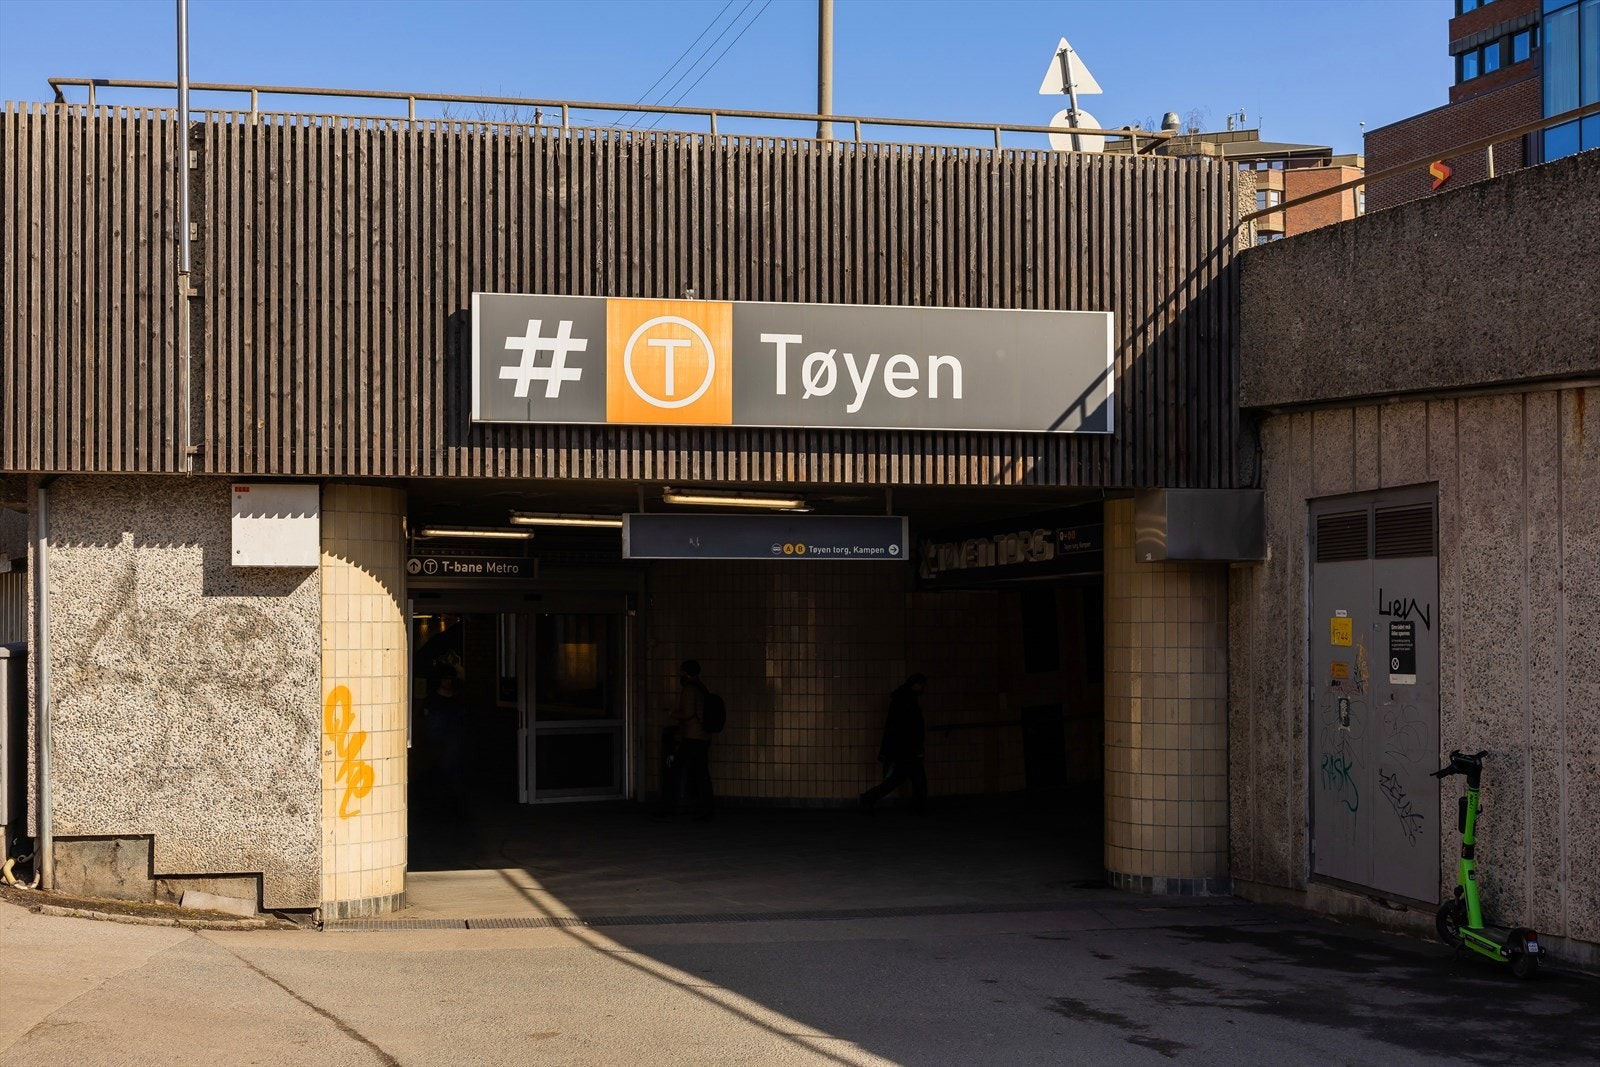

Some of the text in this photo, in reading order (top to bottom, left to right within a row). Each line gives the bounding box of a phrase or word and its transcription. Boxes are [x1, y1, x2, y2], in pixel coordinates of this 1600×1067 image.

[760, 333, 963, 413] Tøyen
[809, 545, 831, 555] Tøyen
[833, 545, 851, 555] torg,
[853, 546, 885, 555] Kampen
[442, 561, 483, 573] T-bane
[486, 562, 519, 573] Metro
